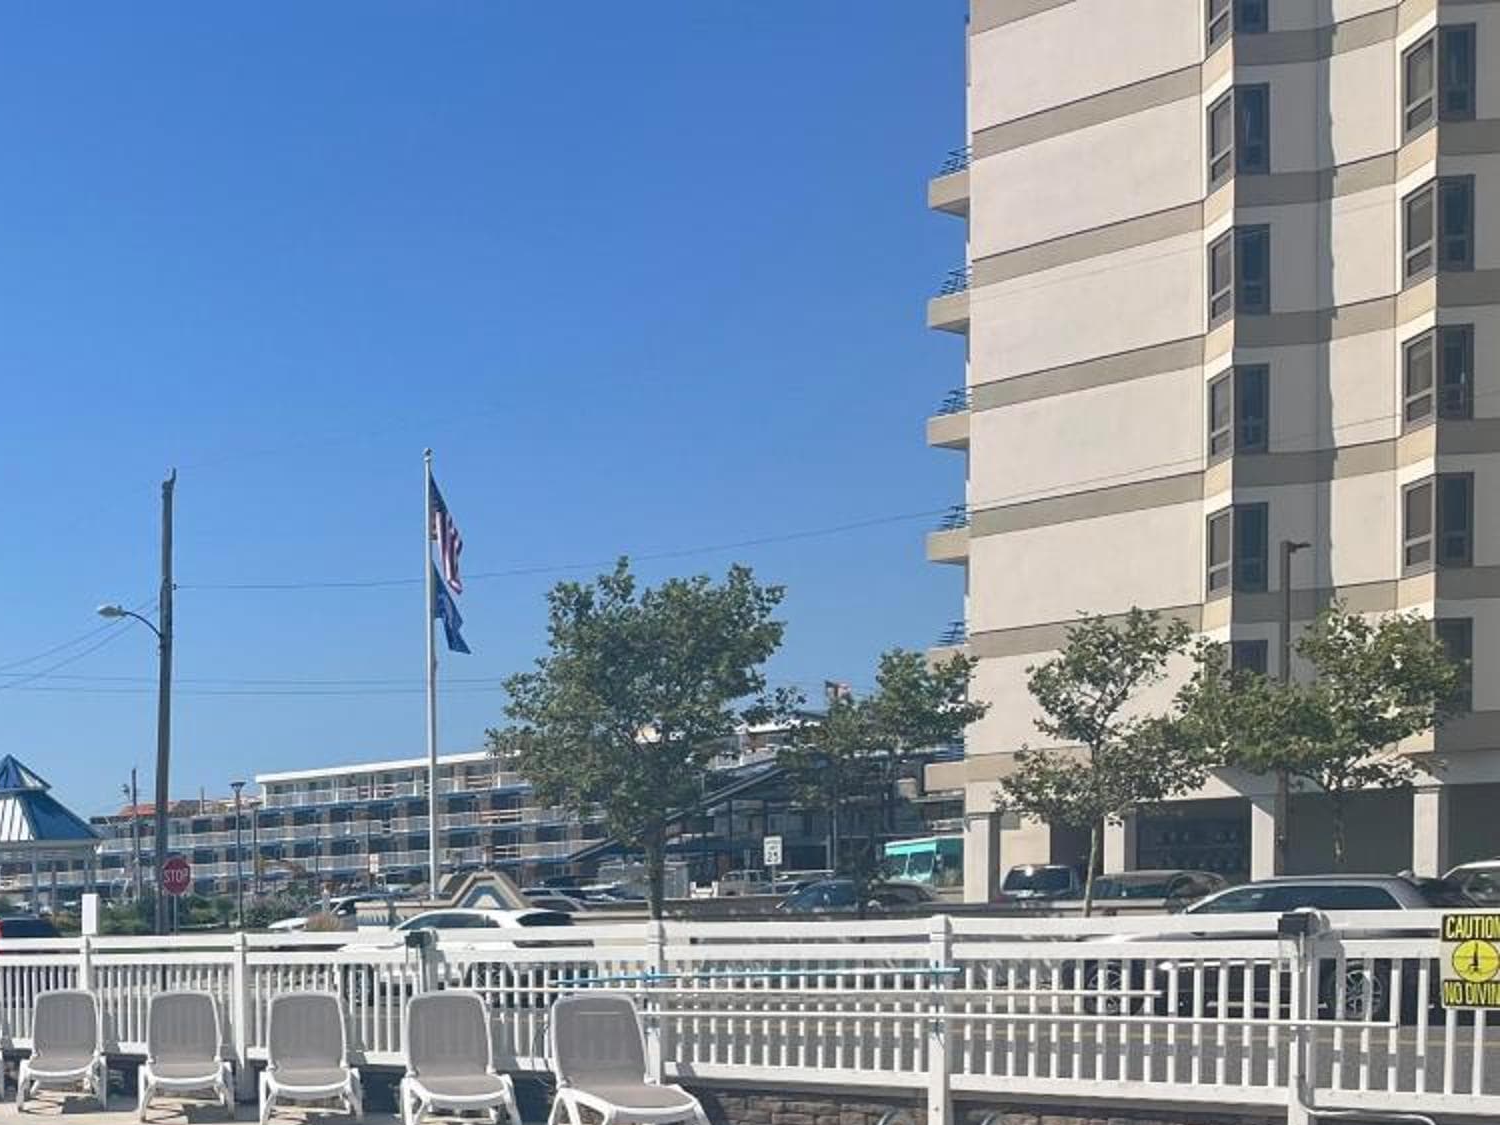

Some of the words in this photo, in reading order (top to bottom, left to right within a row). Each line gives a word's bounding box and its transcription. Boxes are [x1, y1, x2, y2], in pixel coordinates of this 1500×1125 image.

[164, 867, 189, 882] STOP
[1446, 915, 1500, 938] CAUTION
[1444, 982, 1462, 1004] NO
